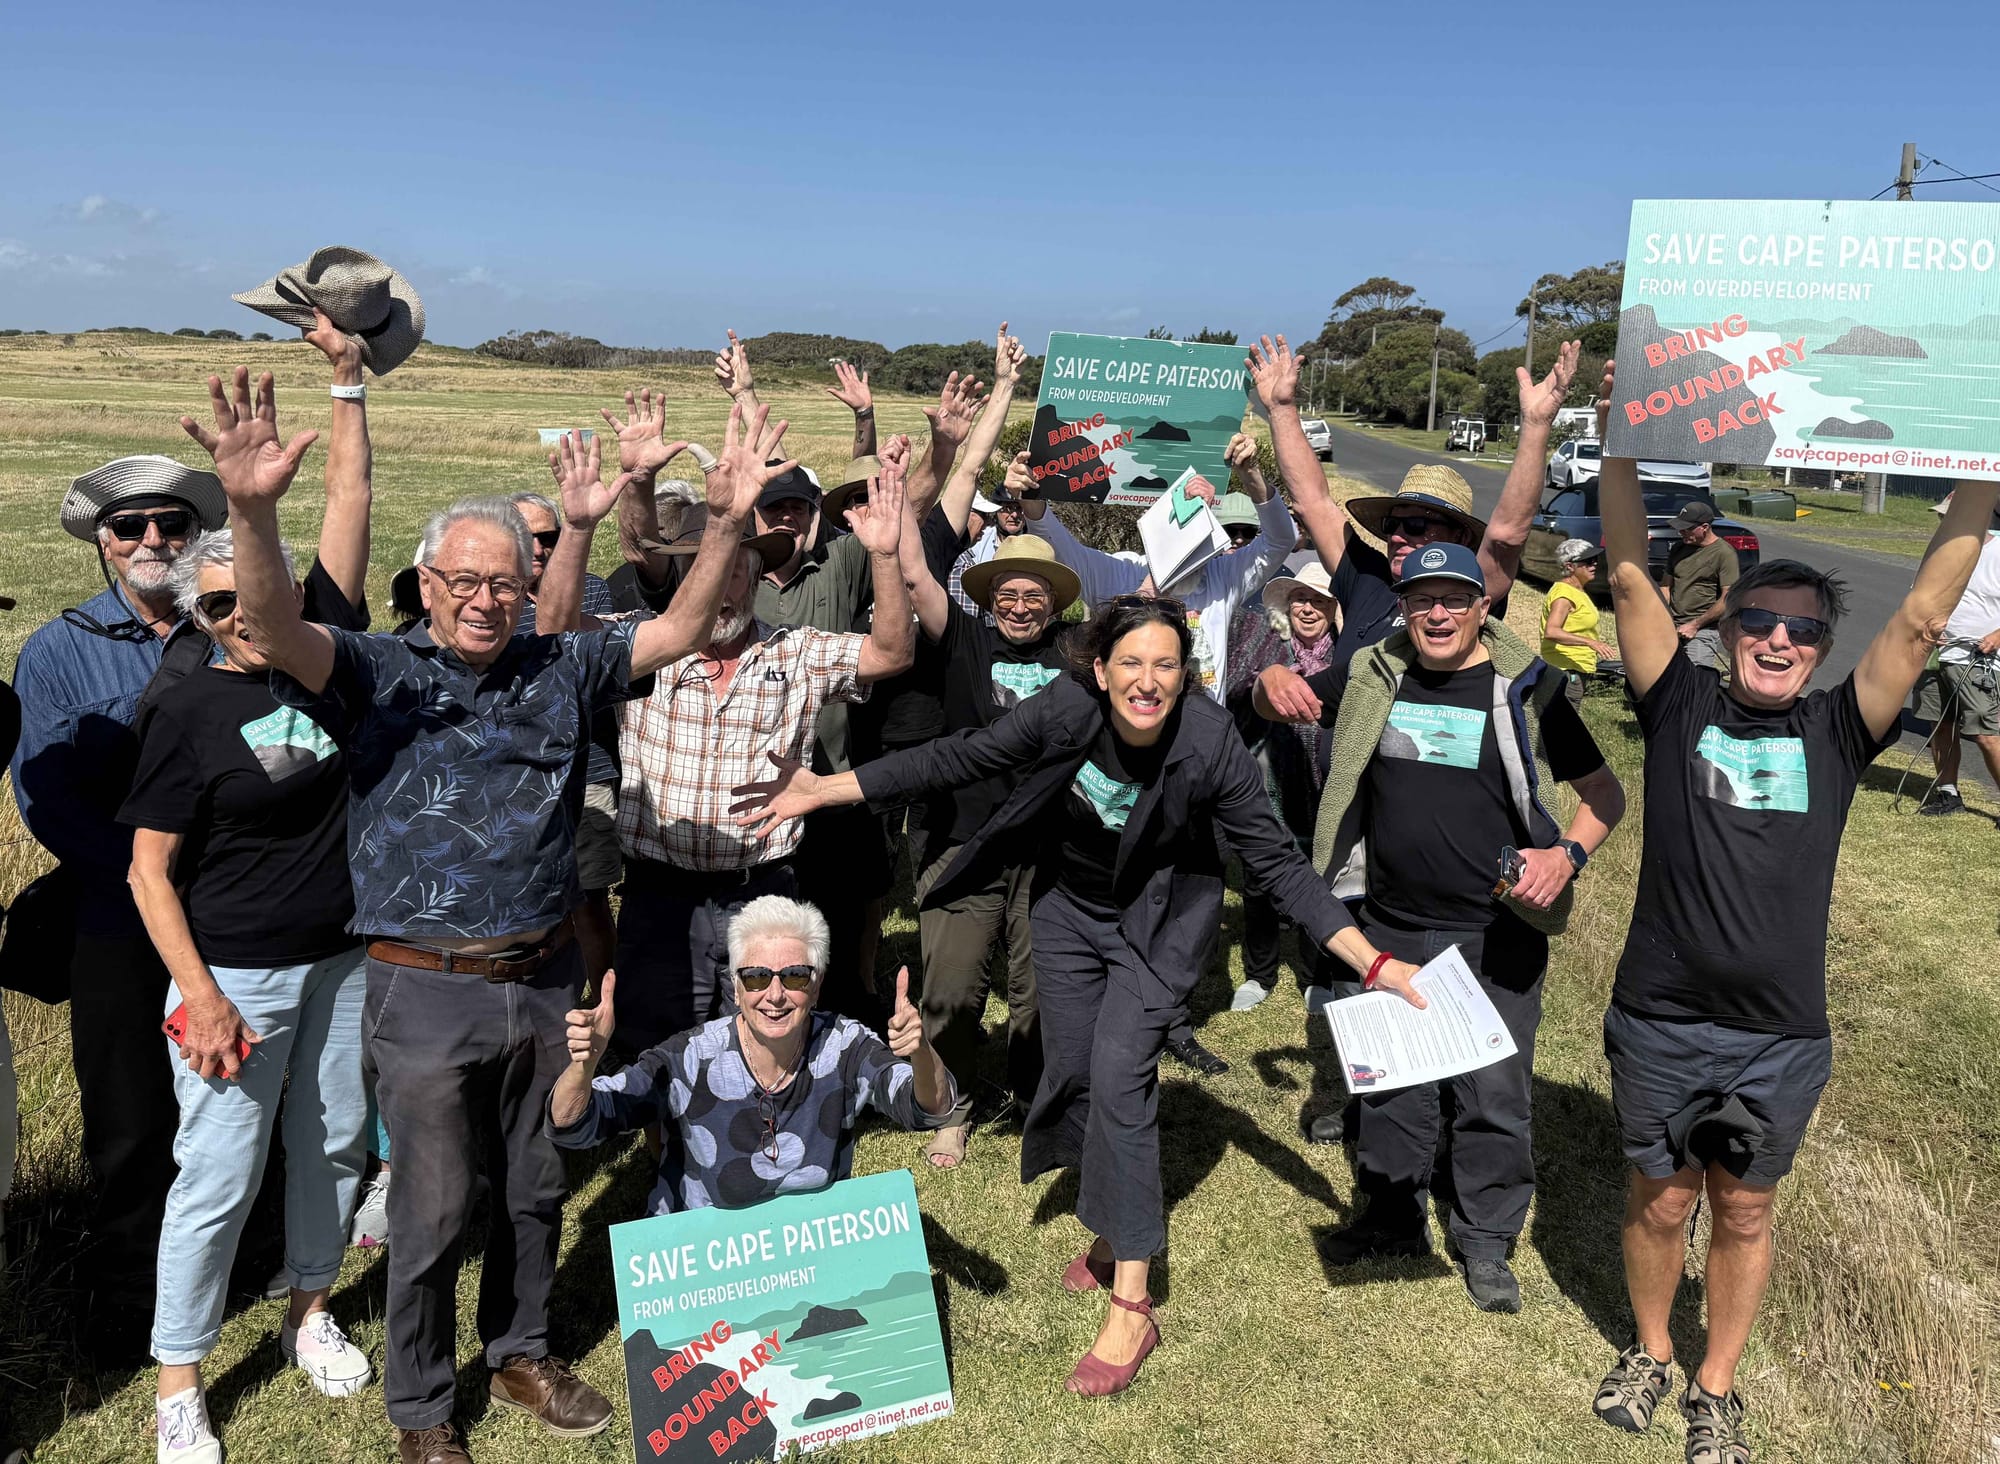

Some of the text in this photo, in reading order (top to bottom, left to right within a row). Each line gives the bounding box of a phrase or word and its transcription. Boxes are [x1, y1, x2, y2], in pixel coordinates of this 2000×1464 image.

[1644, 233, 2000, 272] SAVE CAPE PATERSO
[1639, 278, 1874, 301] FROM OVERDEVELOPMENT
[1643, 313, 1748, 368] BRING
[1053, 356, 1246, 391] SAVE CAPE PATERSON
[1624, 337, 1807, 426] BOUNDARY
[1048, 387, 1171, 406] FROM OVERDEVELOPMENT
[1047, 412, 1106, 447] BRING
[1691, 392, 1785, 444] BACK
[1032, 428, 1134, 481] BOUNDARY
[1068, 462, 1118, 493] BACK
[247, 719, 276, 737] SAVE
[1413, 709, 1435, 718] CAPE
[1437, 711, 1481, 723] PATERSON
[1701, 730, 1802, 755] SAVE CAPE PATERSON
[1082, 765, 1099, 783] SAVE
[1098, 778, 1119, 794] CAPE
[629, 1201, 911, 1288] SAVE CAPE PATERSON
[633, 1266, 817, 1321] FROM OVERDEVELOPMENT
[651, 1319, 733, 1393] BRING
[646, 1328, 783, 1457] BOUNDARY
[707, 1388, 778, 1458] BACK
